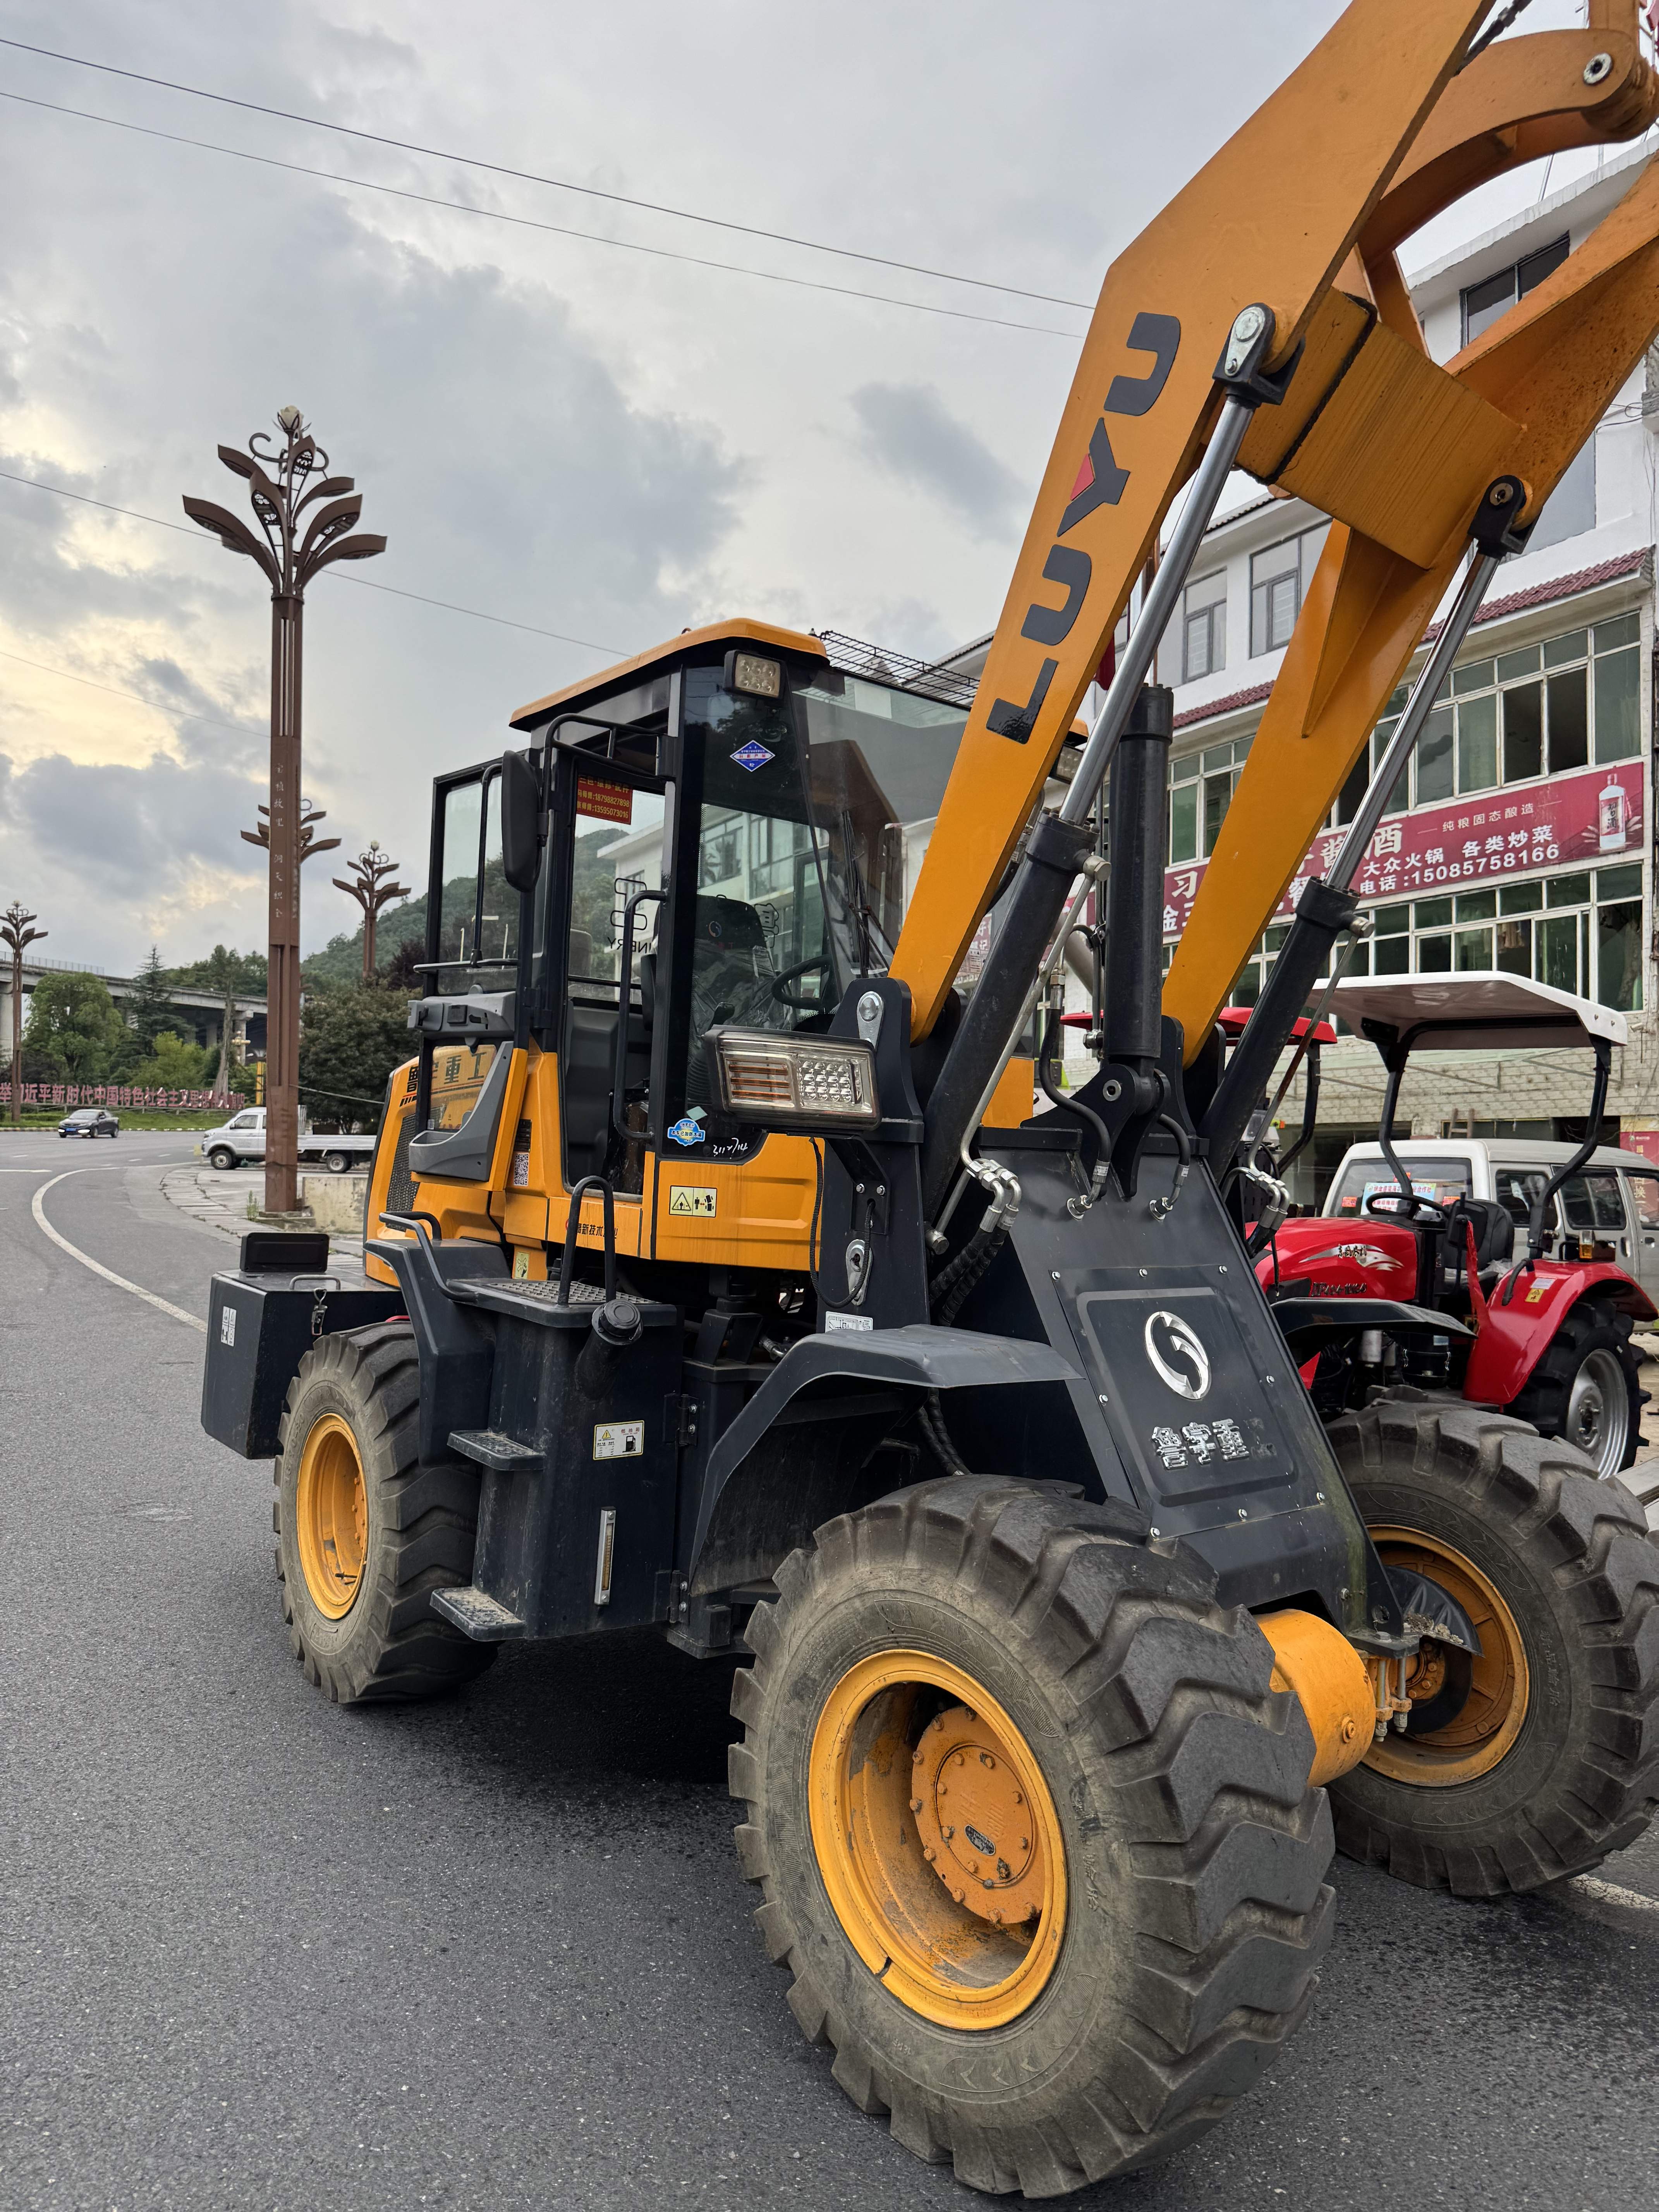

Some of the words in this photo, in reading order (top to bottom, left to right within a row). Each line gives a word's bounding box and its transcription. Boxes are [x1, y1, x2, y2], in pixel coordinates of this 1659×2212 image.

[986, 312, 1180, 744] LUYU
[1442, 804, 1534, 832] 纯粮固态酿造
[1363, 847, 1443, 878] 大众火锅
[1462, 824, 1553, 858] 各类炒菜
[577, 1223, 618, 1239] 高新技术
